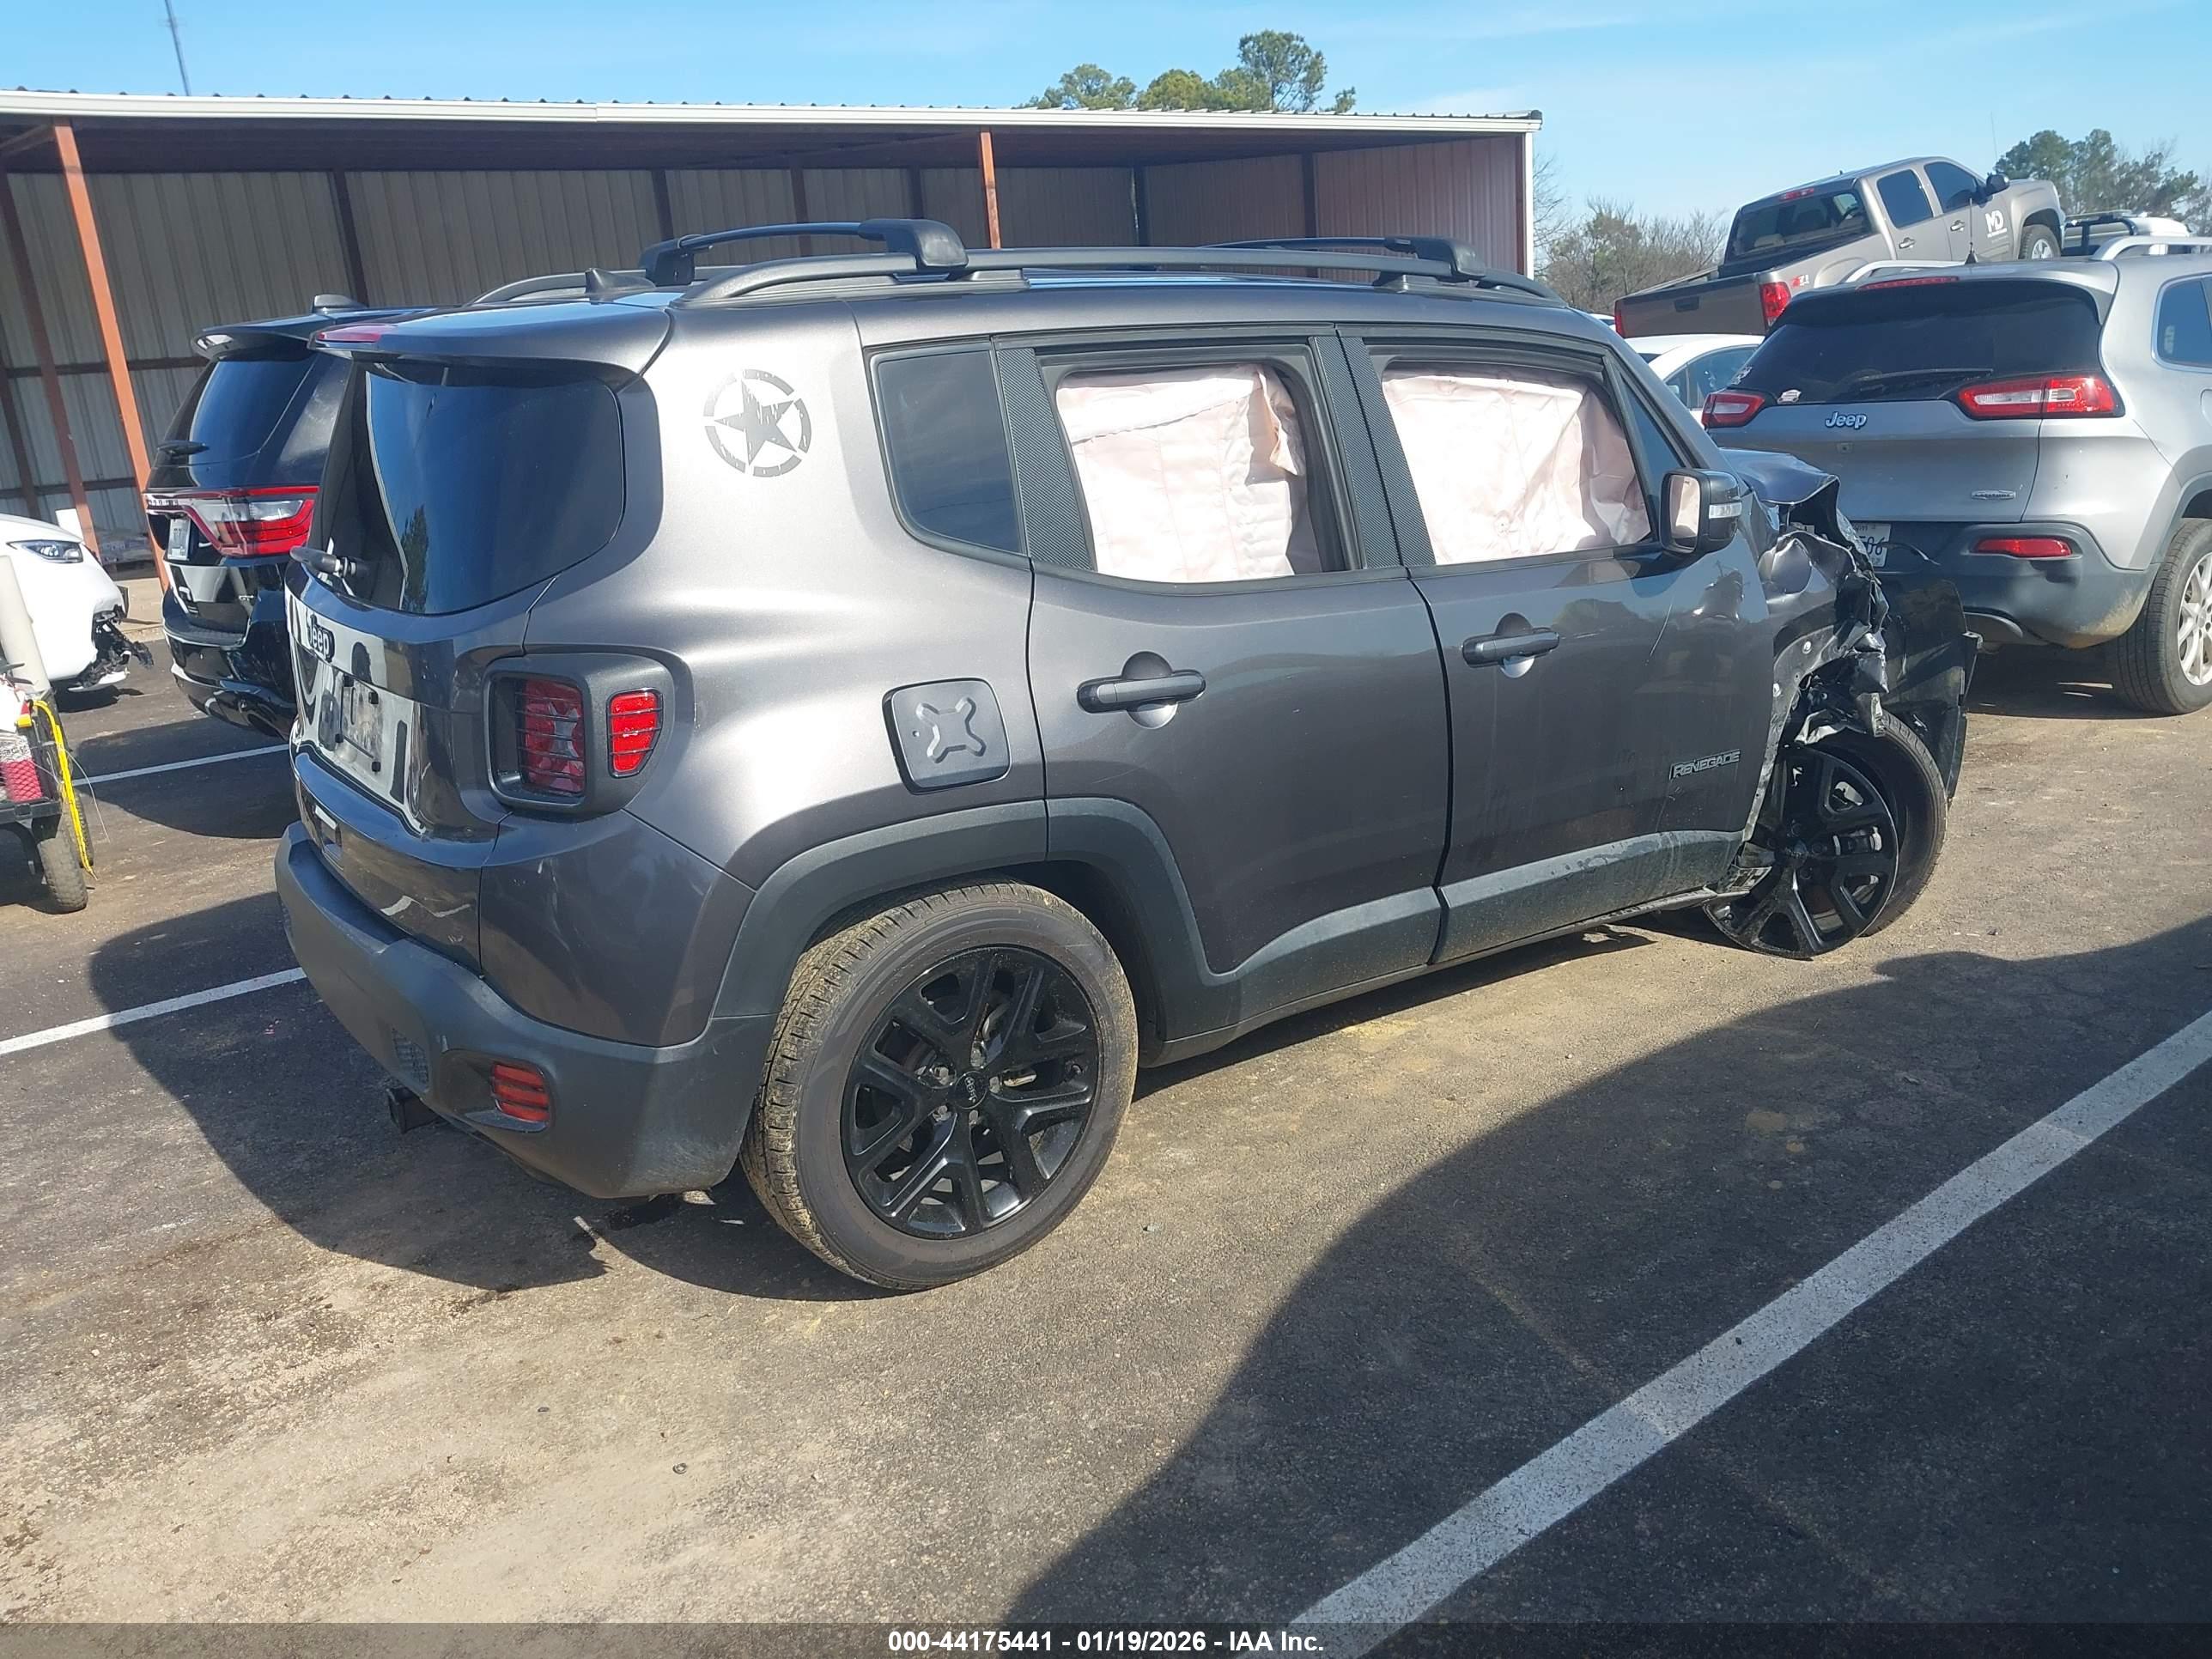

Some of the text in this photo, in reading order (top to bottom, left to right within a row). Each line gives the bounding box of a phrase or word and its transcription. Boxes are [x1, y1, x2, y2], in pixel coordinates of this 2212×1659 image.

[1984, 210, 2004, 233] MD
[1825, 411, 1867, 429] Jeep
[307, 613, 335, 663] Jeep
[1673, 750, 1741, 778] RENEGADE
